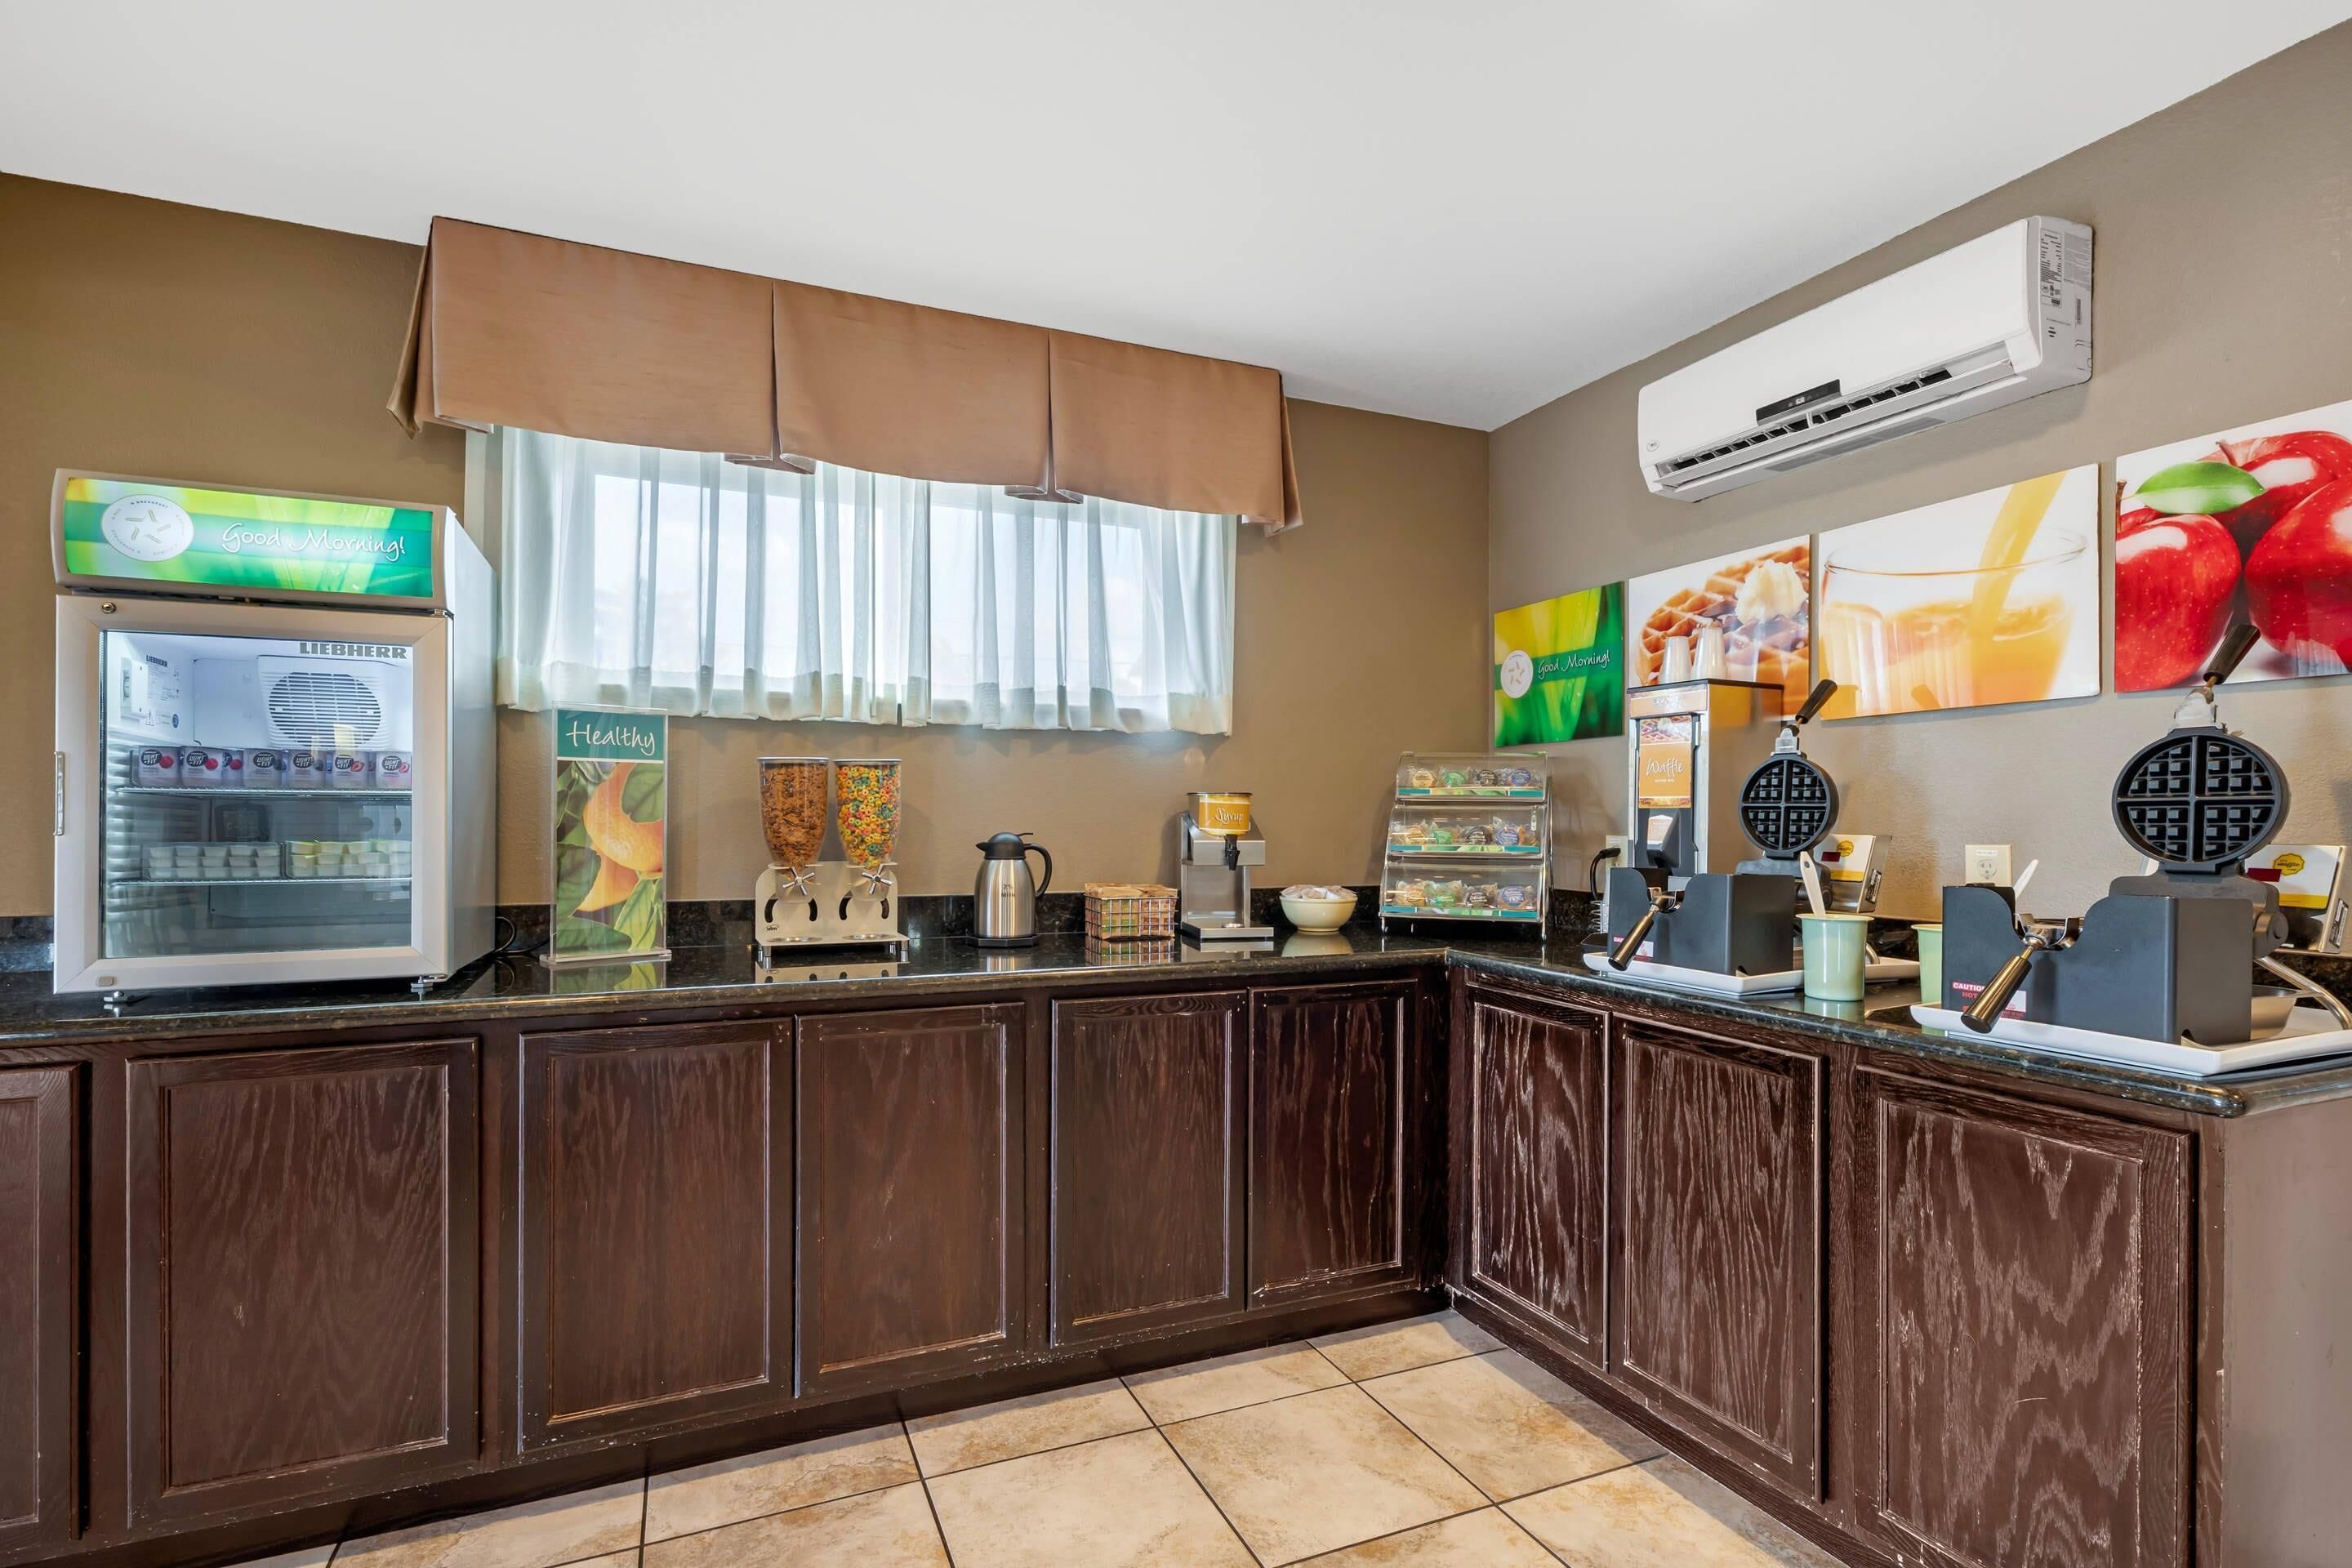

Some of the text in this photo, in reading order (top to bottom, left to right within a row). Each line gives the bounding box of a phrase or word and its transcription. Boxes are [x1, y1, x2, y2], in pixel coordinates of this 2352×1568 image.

[221, 523, 282, 553] Good
[287, 529, 406, 562] Morning!
[146, 654, 168, 667] LIEBHERR
[300, 642, 407, 659] LIEBHERR
[1538, 649, 1610, 680] Good Morning!
[565, 720, 656, 756] Healthy
[1646, 757, 1685, 777] Waffle
[1214, 808, 1243, 826] Syrup
